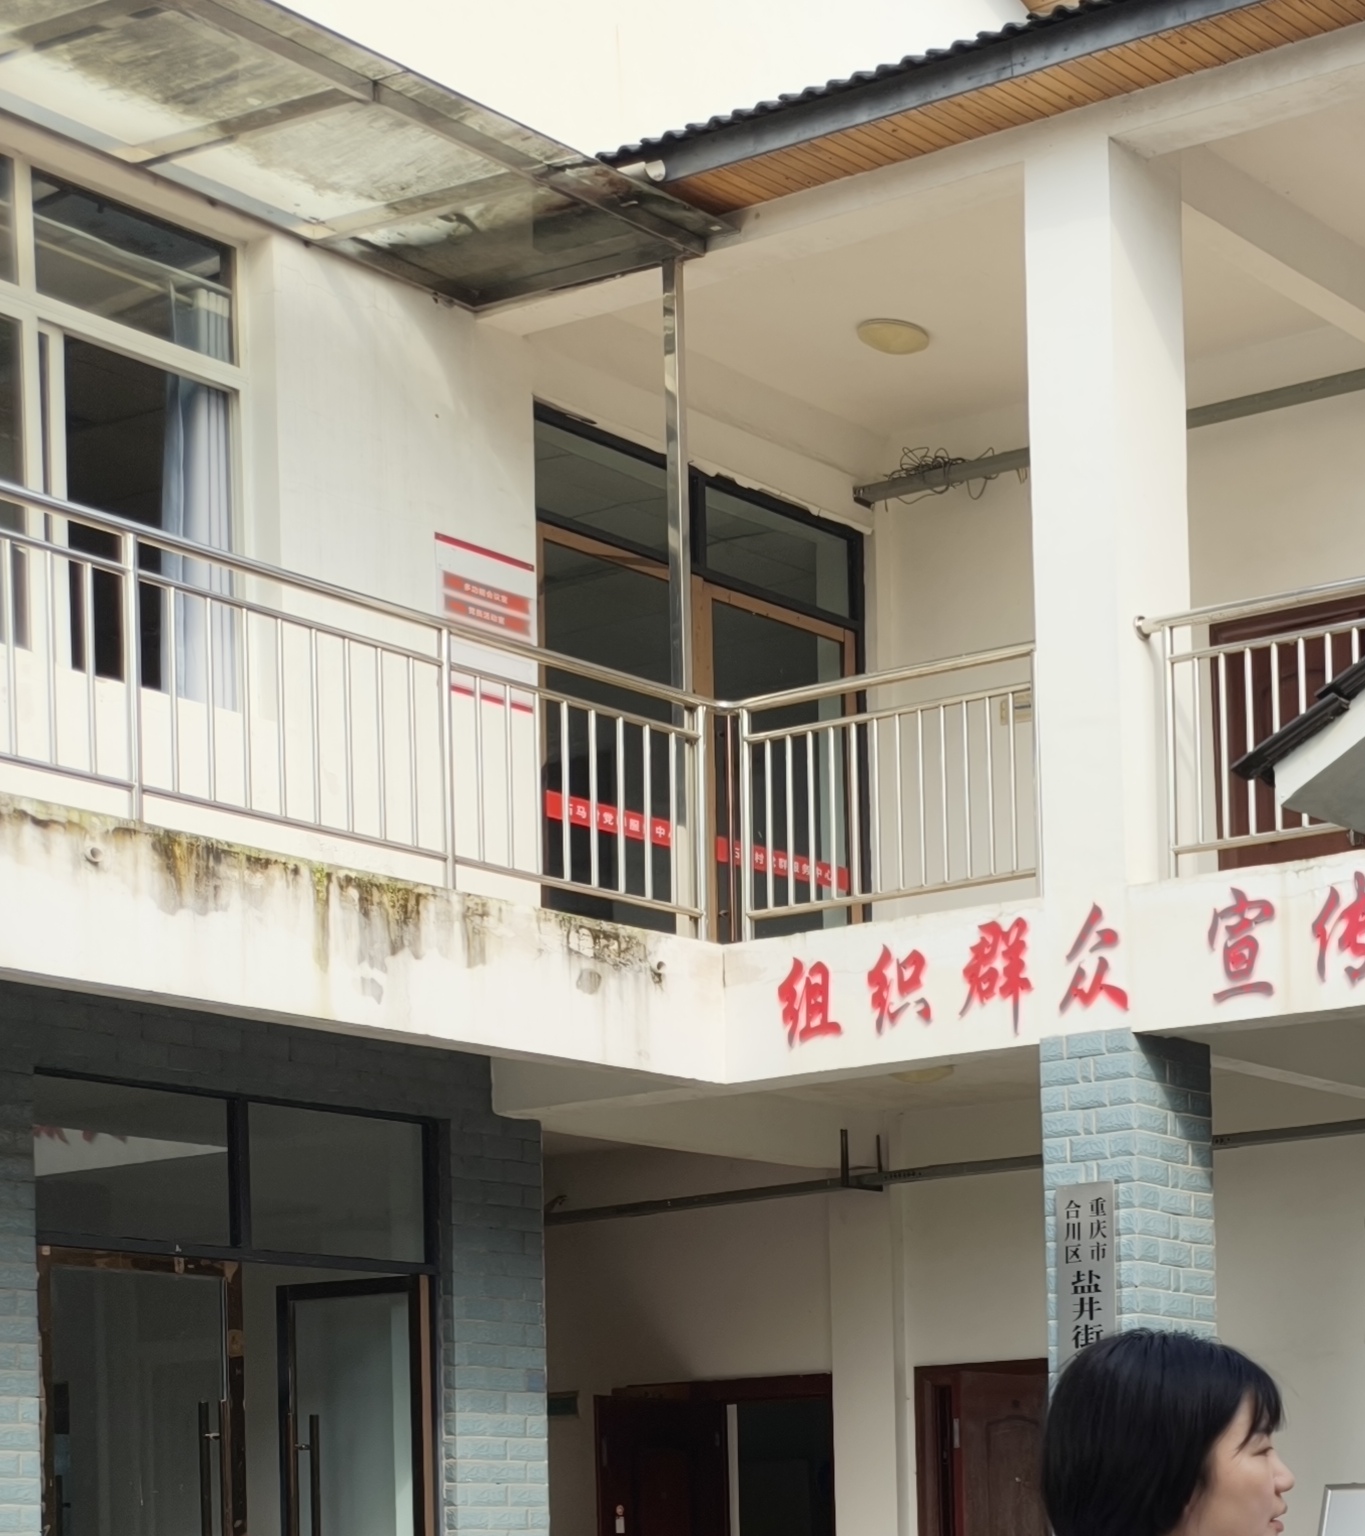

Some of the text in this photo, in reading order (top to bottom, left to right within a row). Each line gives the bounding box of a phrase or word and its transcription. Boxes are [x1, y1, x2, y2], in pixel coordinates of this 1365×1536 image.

[778, 903, 1129, 1046] 组织群众
[1065, 1200, 1082, 1264] 合川区
[1089, 1197, 1107, 1261] 重庆市
